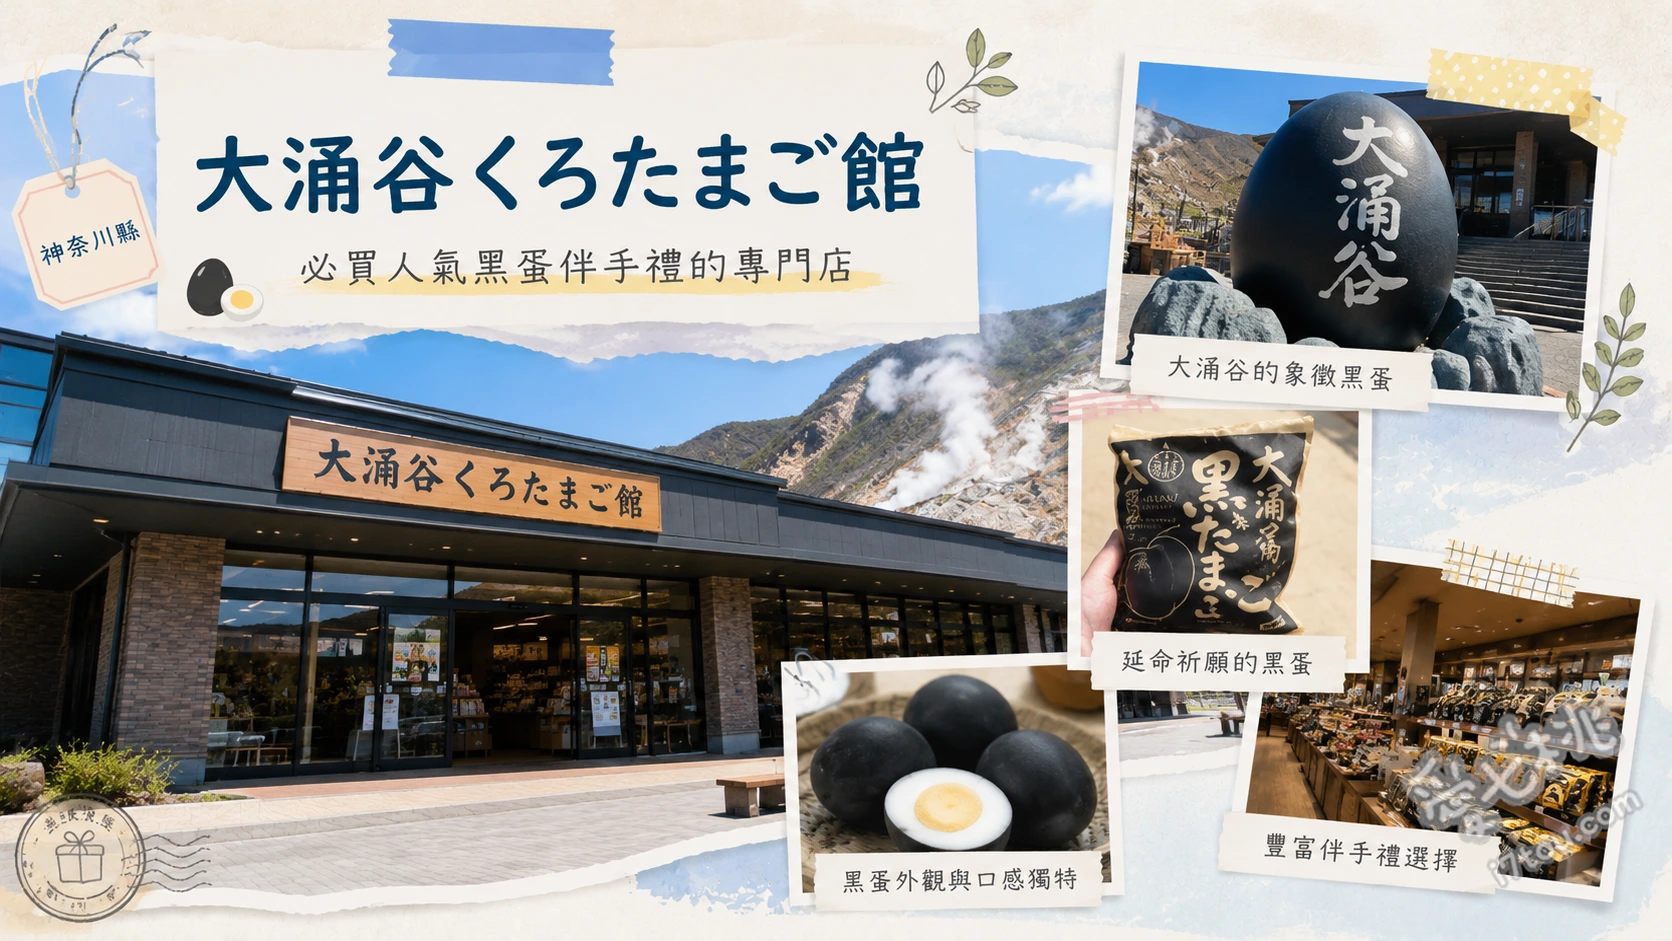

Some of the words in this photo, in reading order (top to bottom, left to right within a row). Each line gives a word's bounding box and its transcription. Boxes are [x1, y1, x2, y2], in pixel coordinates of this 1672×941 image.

[1319, 116, 1408, 308] 大涌谷
[314, 438, 643, 519] 大涌谷くろたまご館
